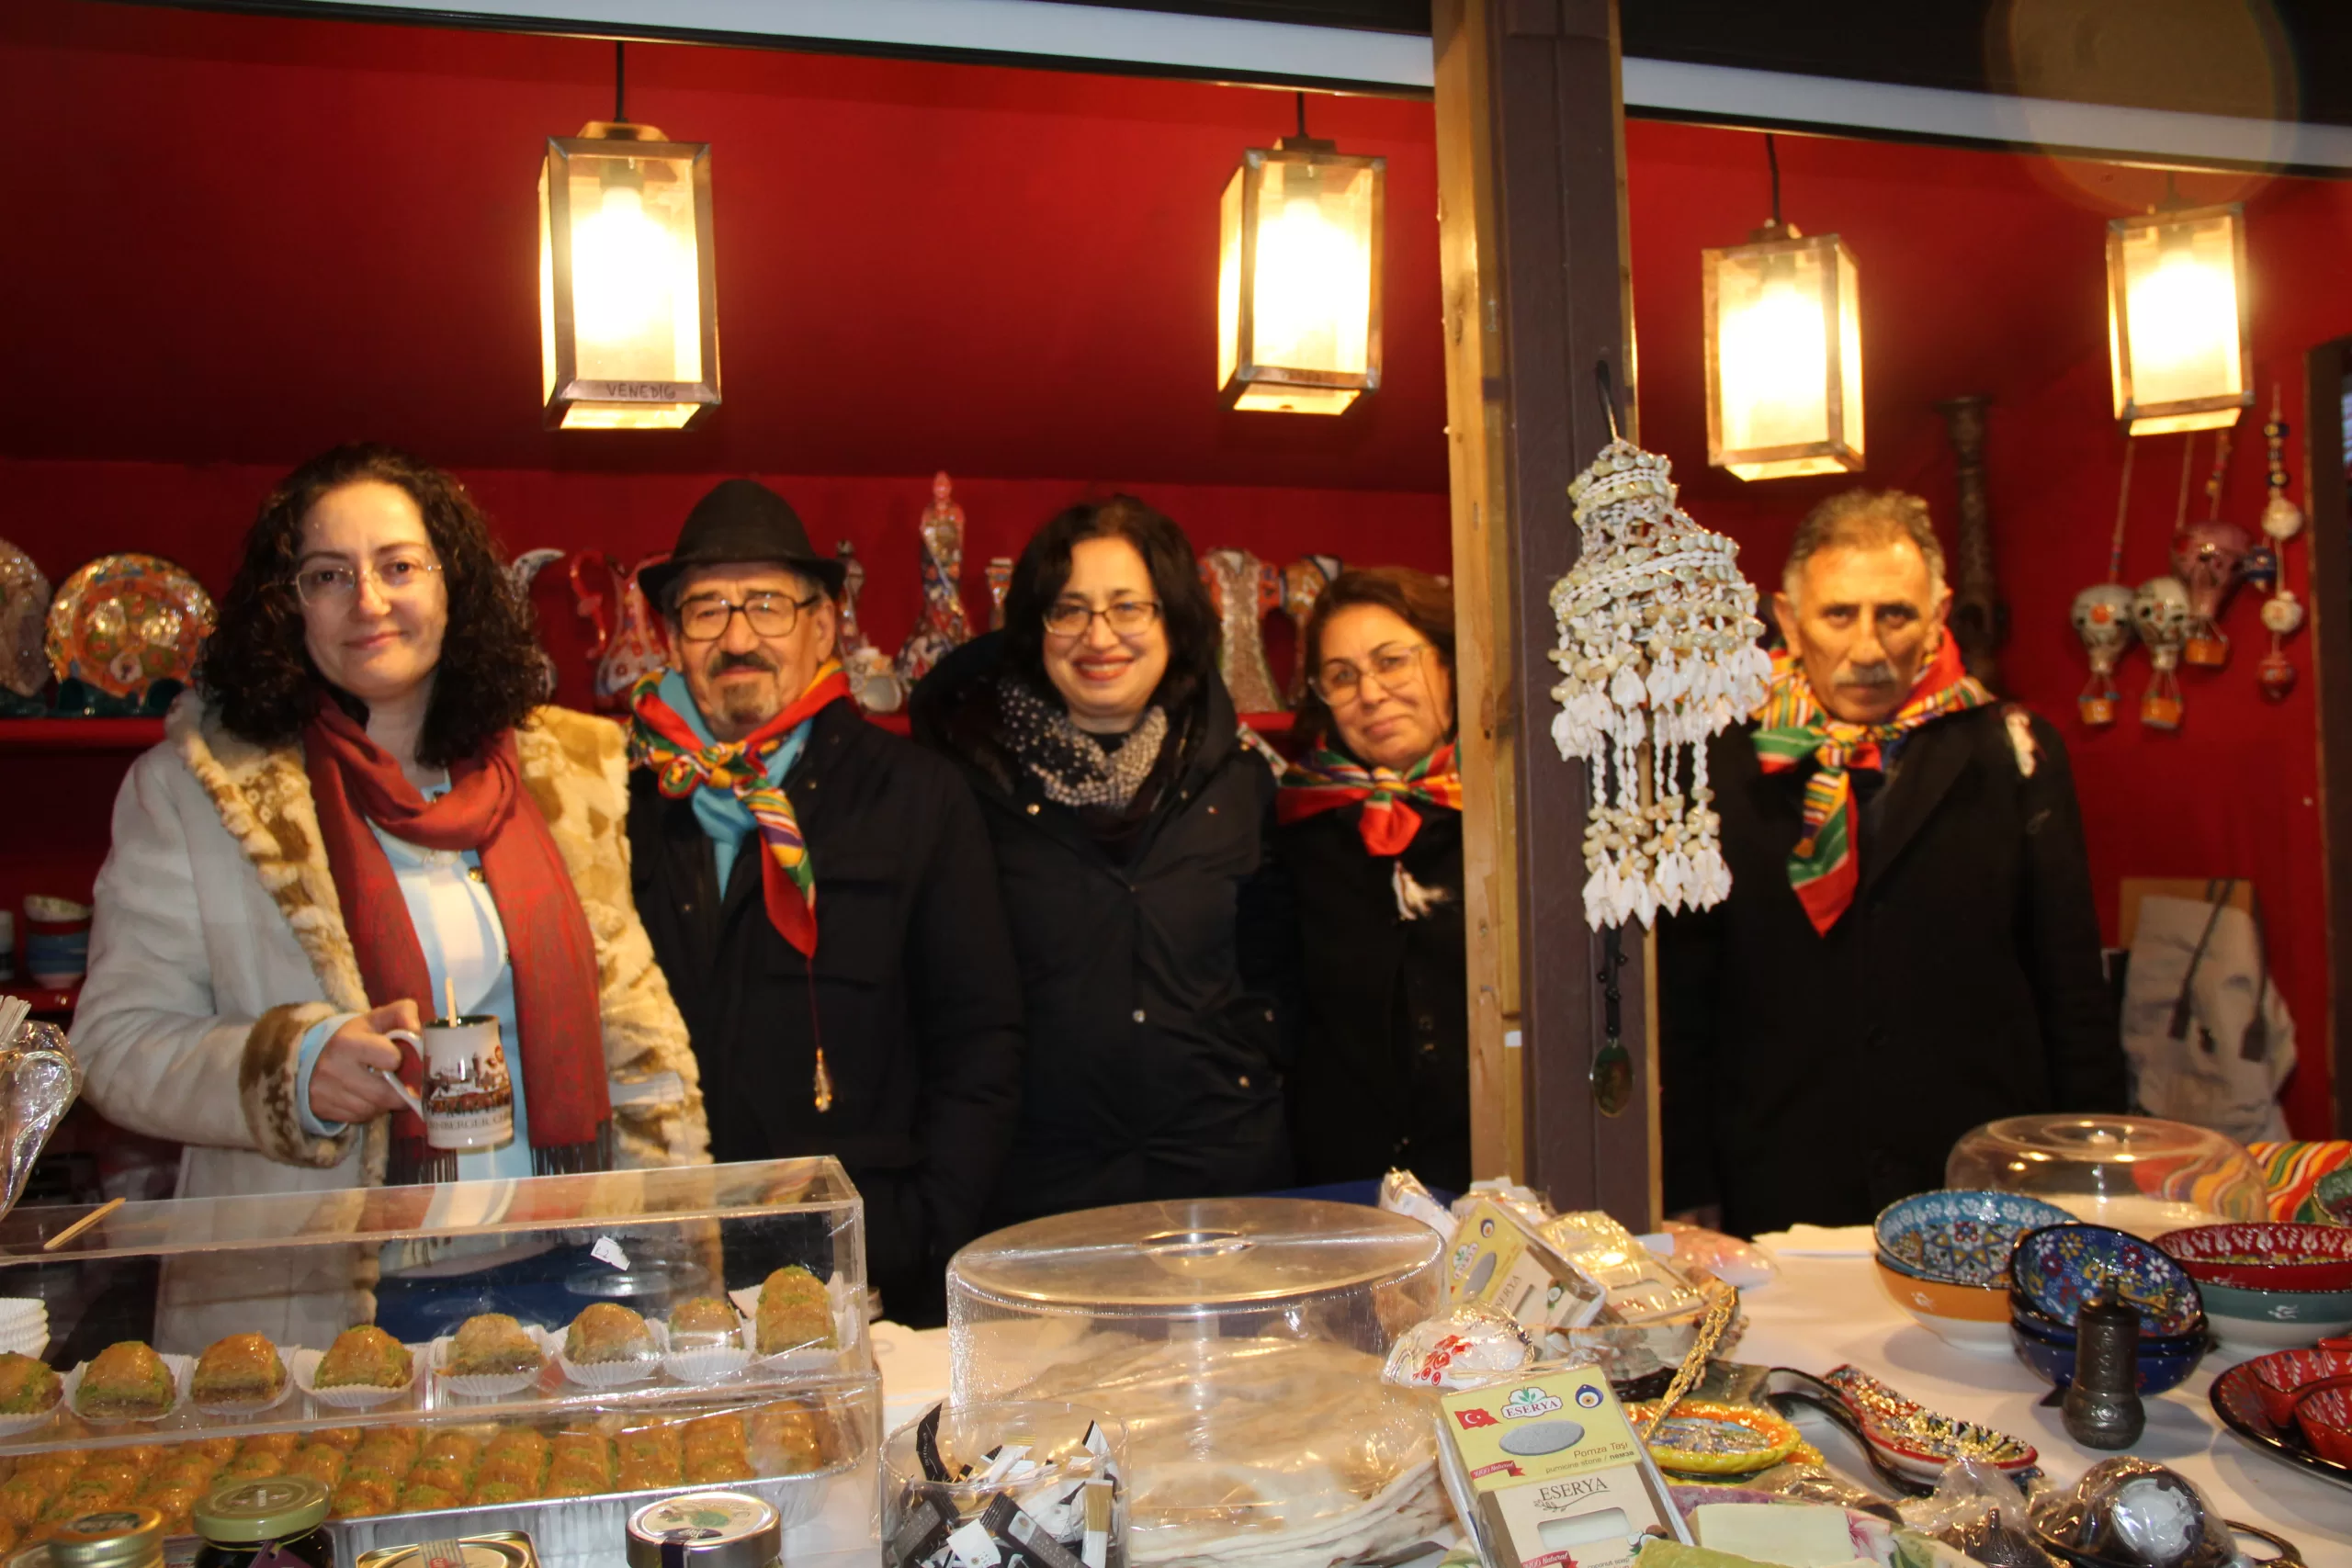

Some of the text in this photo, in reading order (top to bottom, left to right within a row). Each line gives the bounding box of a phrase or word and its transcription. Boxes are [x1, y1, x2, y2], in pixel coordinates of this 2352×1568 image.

[606, 382, 677, 400] VENEDIG
[1506, 1400, 1558, 1416] ESERYA
[1573, 1441, 1628, 1459] Pomza Taşı
[1545, 1462, 1579, 1473] pumicine
[1581, 1457, 1601, 1466] stone
[1540, 1477, 1608, 1501] ESERYA
